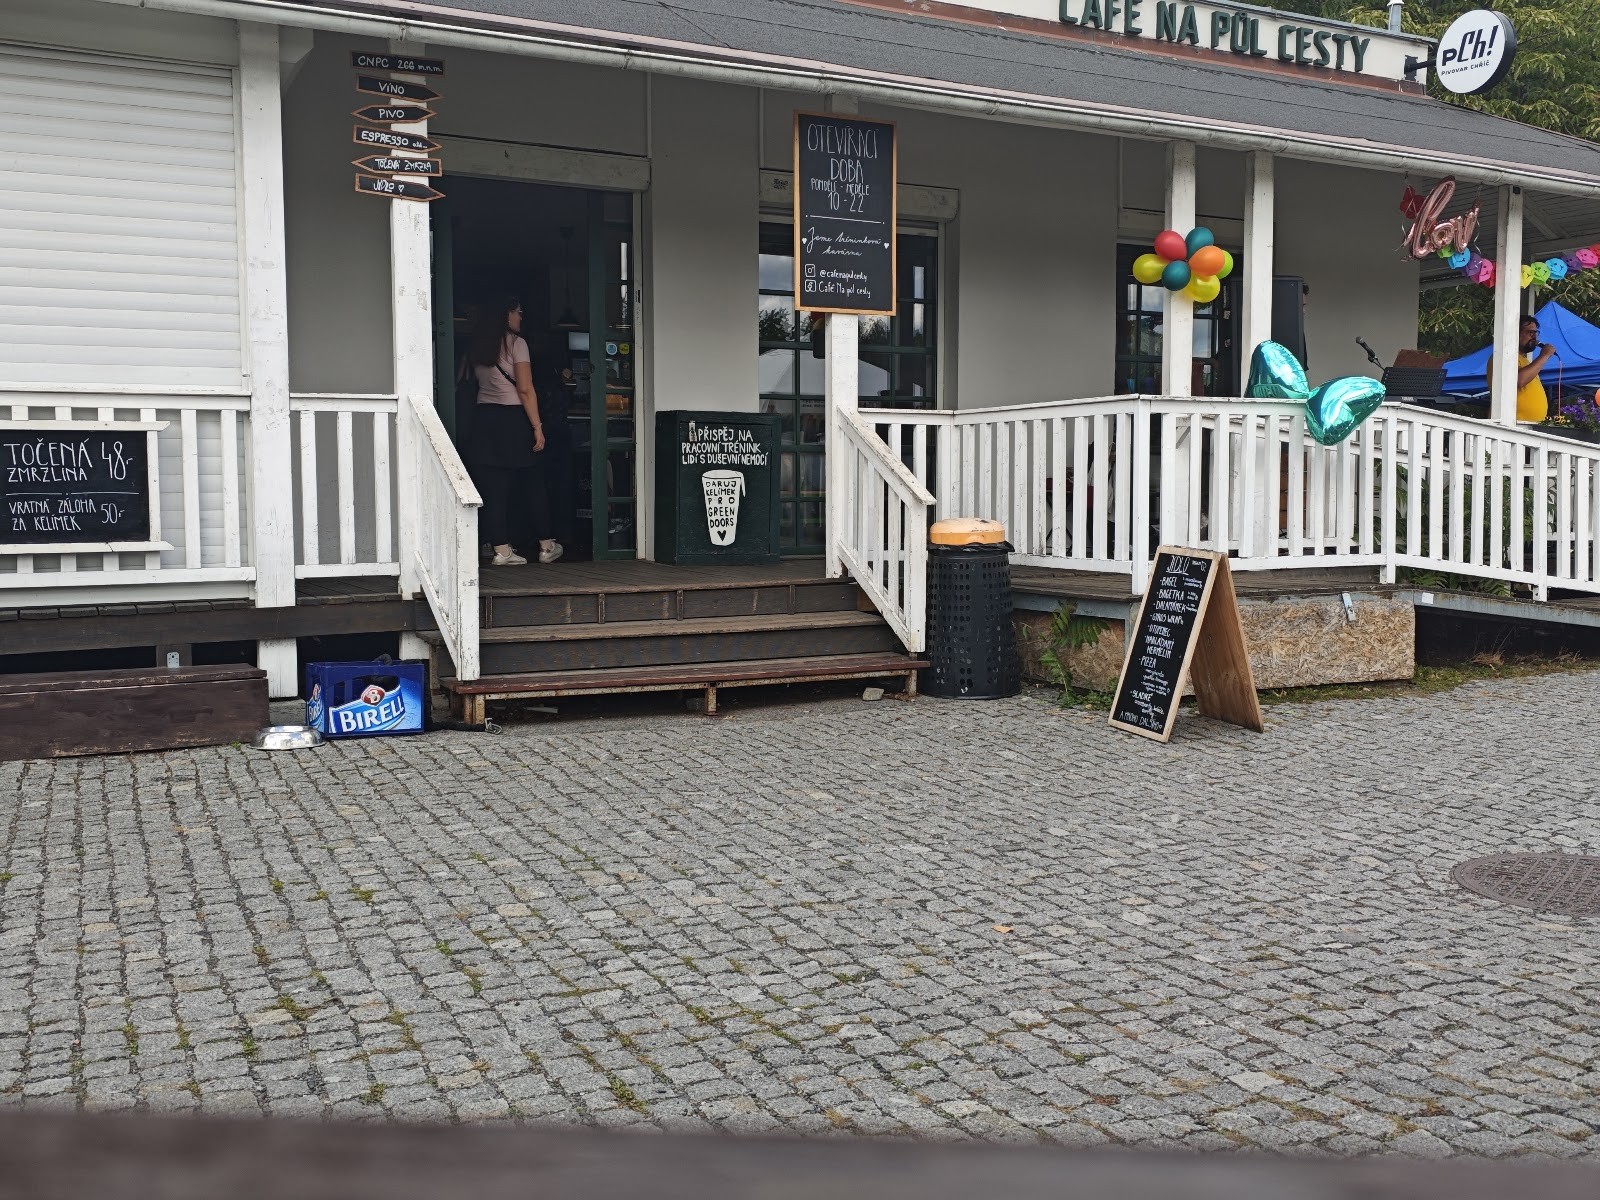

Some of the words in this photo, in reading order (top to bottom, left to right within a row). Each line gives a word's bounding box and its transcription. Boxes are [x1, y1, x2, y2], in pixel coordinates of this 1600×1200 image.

[1156, 0, 1199, 44] NA
[1210, 9, 1267, 56] PŮL
[1278, 25, 1370, 72] CESTY
[357, 55, 389, 68] CNPC
[1441, 66, 1468, 76] PIVOVAR
[378, 81, 405, 95] VÍNO
[378, 108, 405, 119] PIVO
[361, 130, 409, 146] ESPRESSO
[830, 158, 864, 183] DOBA
[828, 192, 840, 210] 10
[850, 193, 864, 213] 22
[697, 426, 734, 441] PŘISPĚJ
[738, 429, 753, 442] NA
[3, 438, 93, 468] TOČENÁ
[681, 442, 721, 454] PRACOVNÍ
[721, 440, 761, 453] TRÉNINK
[682, 453, 699, 465] LIDÍ
[700, 454, 706, 464] S
[742, 452, 769, 466] NEMOCÍ
[7, 467, 88, 482] ZMRZLINA
[706, 488, 735, 496] KELÍMEK
[8, 499, 50, 514] VRATNÁ
[58, 498, 97, 513] ZÁLOHA
[708, 507, 734, 517] GREEN
[12, 517, 27, 531] ZA
[34, 514, 81, 531] KELÍMEK
[710, 518, 734, 528] DOORS
[338, 695, 405, 733] BIRELL
